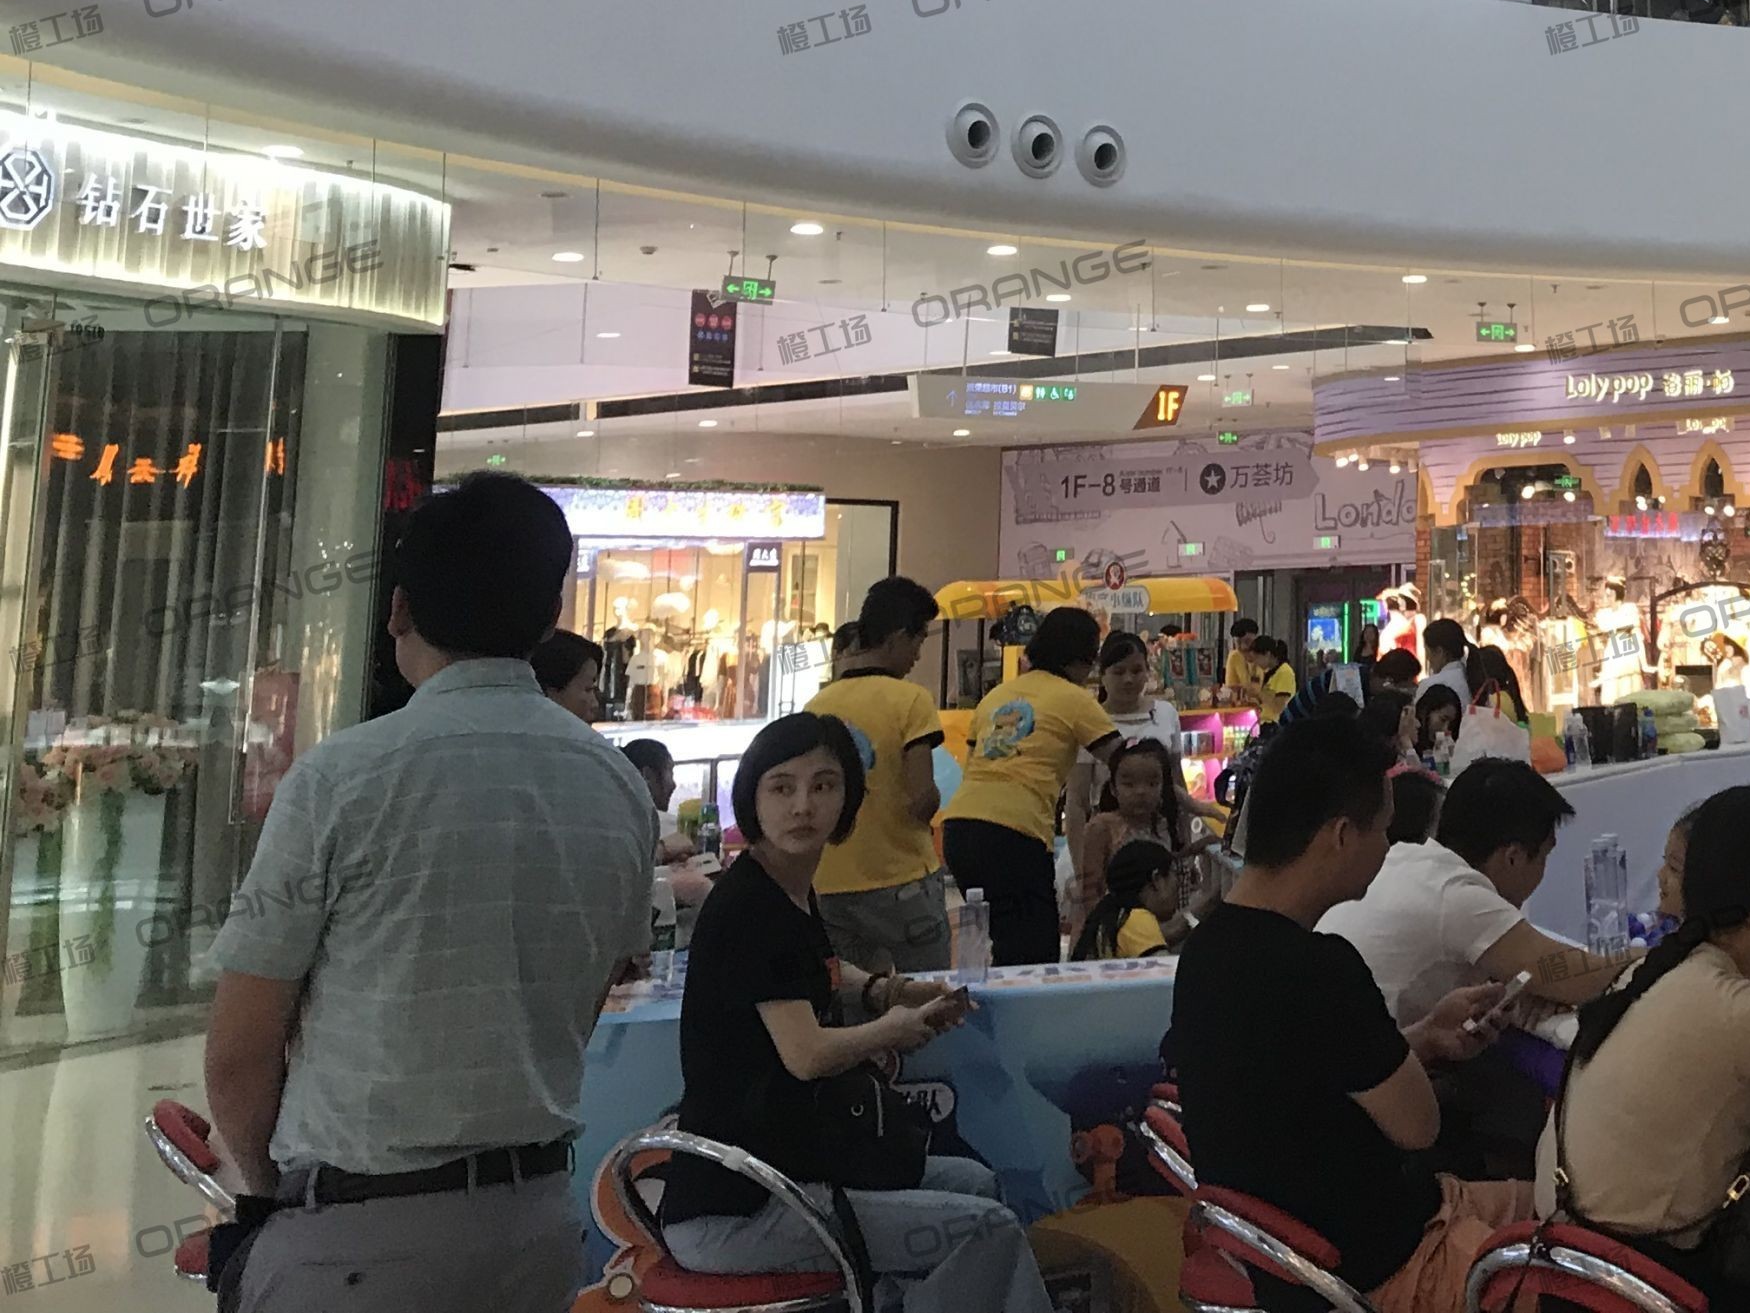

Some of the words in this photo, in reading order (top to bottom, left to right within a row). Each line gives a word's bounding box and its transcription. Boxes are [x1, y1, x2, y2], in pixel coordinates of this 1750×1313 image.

[76, 172, 269, 252] 钻石世家
[1612, 372, 1655, 403] pop
[1157, 390, 1180, 422] 1F
[1060, 473, 1116, 499] 1F-8
[1119, 476, 1161, 495] 号通道
[1230, 462, 1294, 490] 万荟坊
